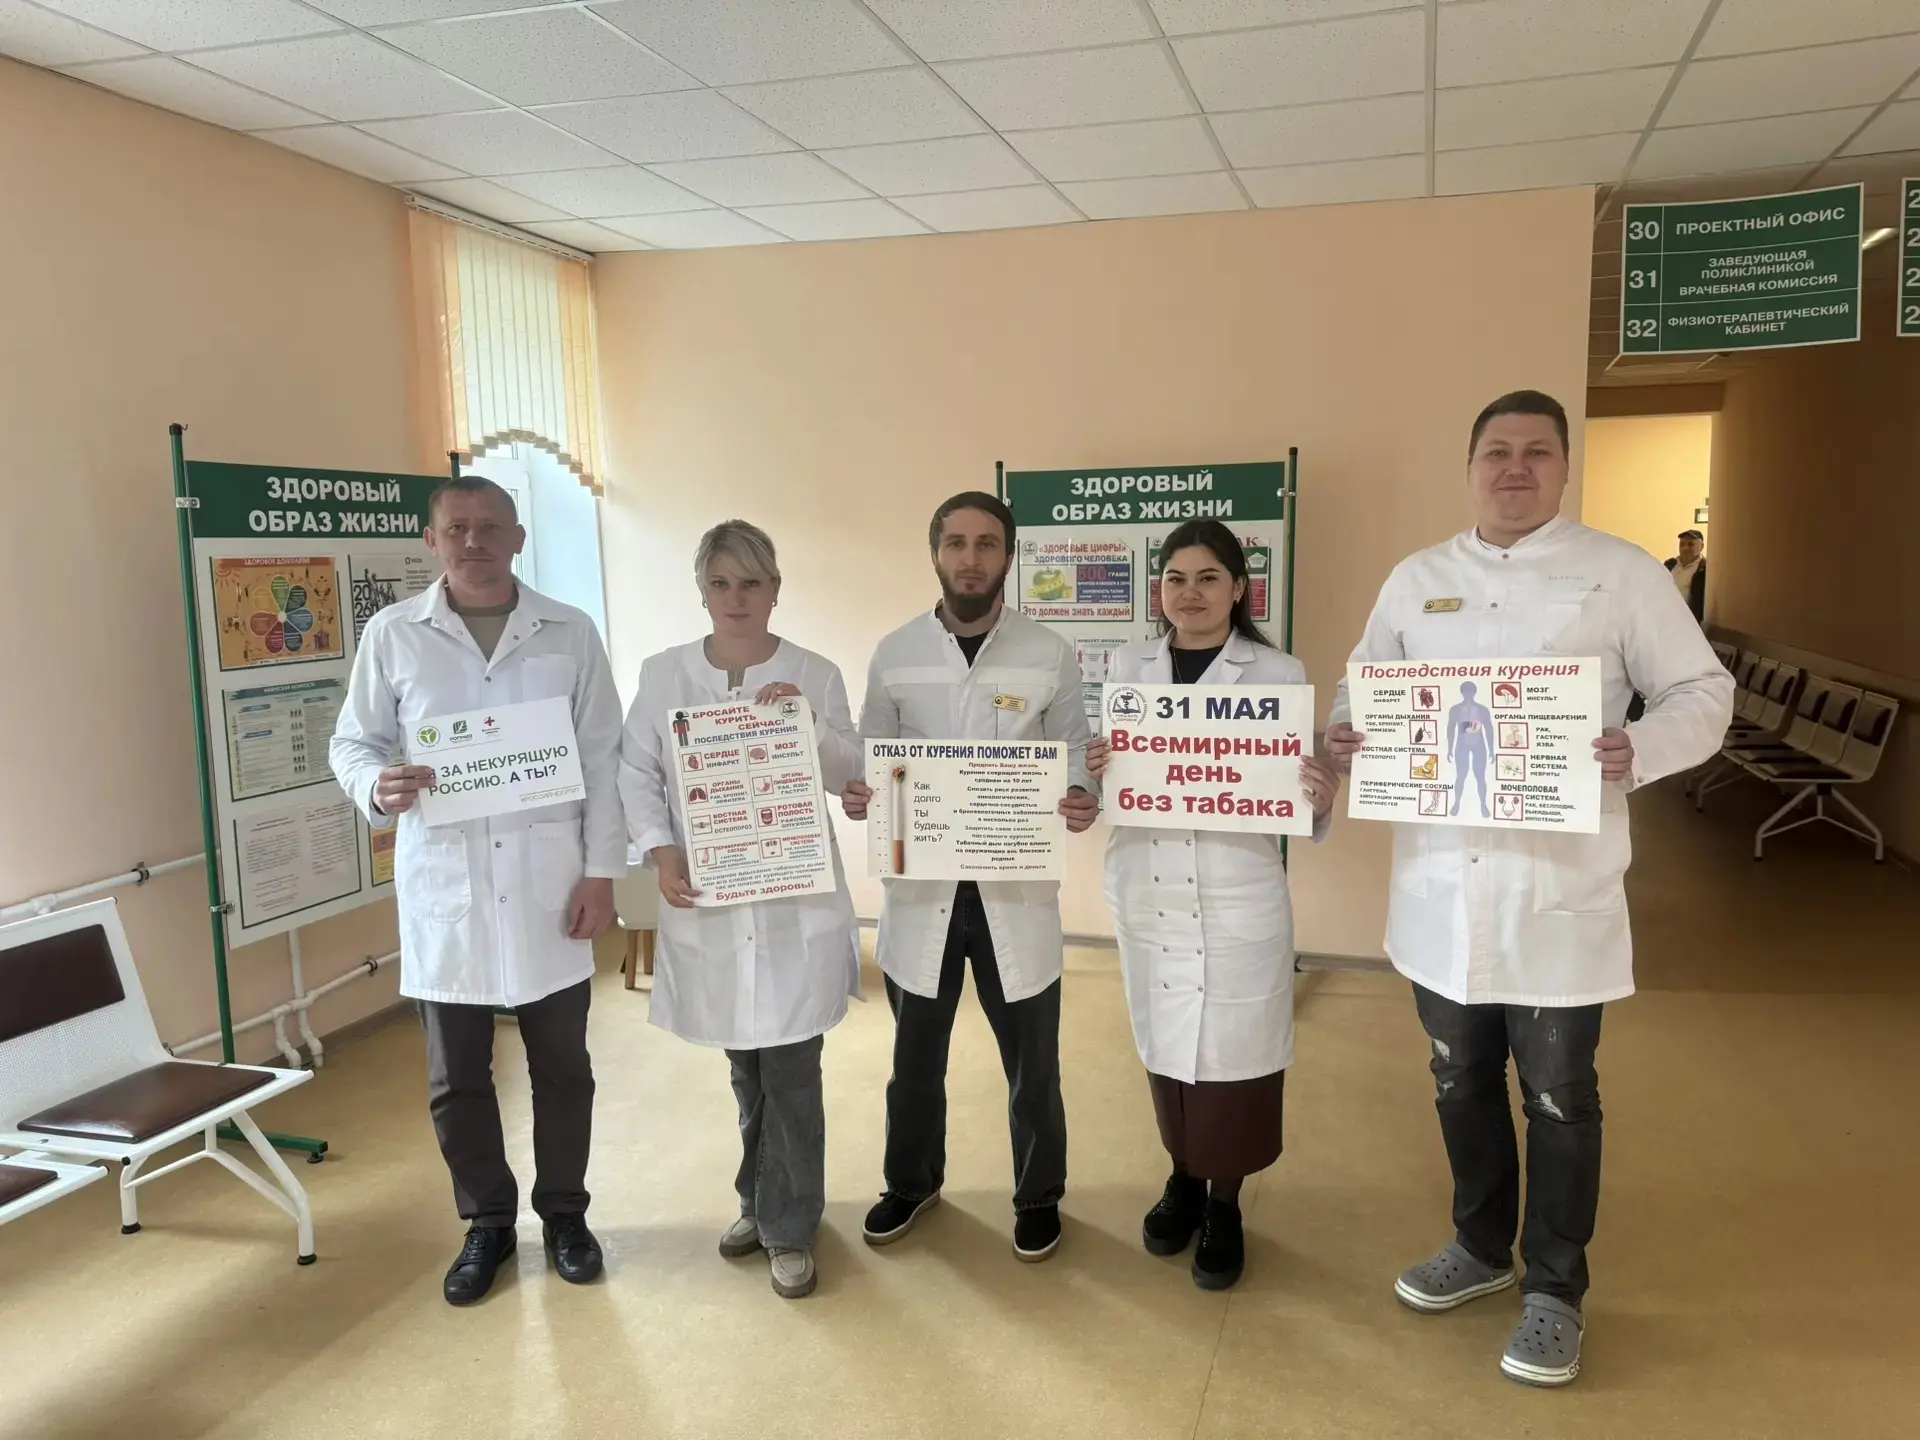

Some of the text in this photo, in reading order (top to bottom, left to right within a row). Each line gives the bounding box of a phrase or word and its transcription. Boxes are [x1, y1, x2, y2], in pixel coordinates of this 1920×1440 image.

[1675, 206, 1846, 235] ПРОЕКТНЫЙ ОФИС
[1629, 221, 1660, 240] 30
[1708, 249, 1807, 268] ЗАВЕДУЮЩАЯ
[1701, 259, 1814, 279] ПОЛИКЛИНИКОЙ
[1629, 270, 1658, 289] 31
[1679, 273, 1838, 296] ВРАЧЕБНАЯ КОМИССИЯ
[1667, 302, 1849, 327] ФИЗИОТЕРАПЕВТИЧЕСКИЙ
[1626, 319, 1657, 338] 32
[1725, 321, 1787, 335] КАБИНЕТ
[266, 476, 401, 503] ЗДОРОВЫЙ
[1070, 469, 1213, 498] ЗДОРОВЫЙ
[1052, 499, 1233, 521] ОБРАЗ ЖИЗНИ
[249, 510, 419, 533] ОБРАЗ ЖИЗНИ
[1034, 555, 1128, 564] ЗДОРОВОГО ЧЕЛОВЕКА
[1078, 566, 1107, 580] 500
[353, 584, 371, 602] 20
[354, 602, 371, 619] 26
[1023, 605, 1130, 618] Это должен знать каждый
[1361, 664, 1580, 680] Последствия курения
[1373, 689, 1406, 697] СЕРДЦЕ
[692, 706, 750, 719] БРОСАЙТЕ
[1156, 696, 1280, 720] 31 МАЯ
[715, 714, 756, 725] КУРИТЬ
[738, 719, 785, 730] СЕЙЧАС!
[694, 725, 798, 744] ПОСЛЕДСТВИЯ КУРЕНИЯ
[775, 742, 799, 750] МОЗГ
[1111, 729, 1301, 760] Всемирный
[704, 749, 740, 760] СЕРДЦЕ
[772, 751, 804, 760] ИНСУЛЬТ
[873, 744, 1057, 760] ОТКАЗ ОТ КУРЕНИЯ ПОМОЖЕТ ВАМ
[441, 765, 463, 778] ЗА
[467, 745, 568, 773] НЕКУРЯЩУЮ
[707, 760, 740, 769] ИНФАРКТ
[429, 775, 505, 796] РОССИЮ.
[509, 771, 521, 783] А
[524, 765, 557, 780] ТЫ?
[1166, 764, 1242, 785] день
[712, 779, 741, 787] ОРГАНЫ
[914, 781, 931, 790] Как
[1360, 780, 1423, 789] ПЕРИФЕРИЧЕСКИЕ
[1500, 784, 1558, 794] МОЧЕПОЛОВАЯ
[913, 795, 941, 804] долго
[1118, 788, 1294, 818] без табака
[1525, 794, 1561, 802] СИСТЕМА
[777, 801, 812, 811] РОТОВАЯ
[778, 808, 814, 817] ПОЛОСТЬ
[713, 810, 746, 819] КОСТНАЯ
[713, 816, 748, 825] СИСТЕМА
[914, 810, 928, 818] ты
[714, 824, 752, 834] ОСТЕОПОРОЗ
[914, 821, 950, 832] будешь
[914, 833, 943, 843] жить?
[716, 880, 815, 901] Будьте здоровы!
